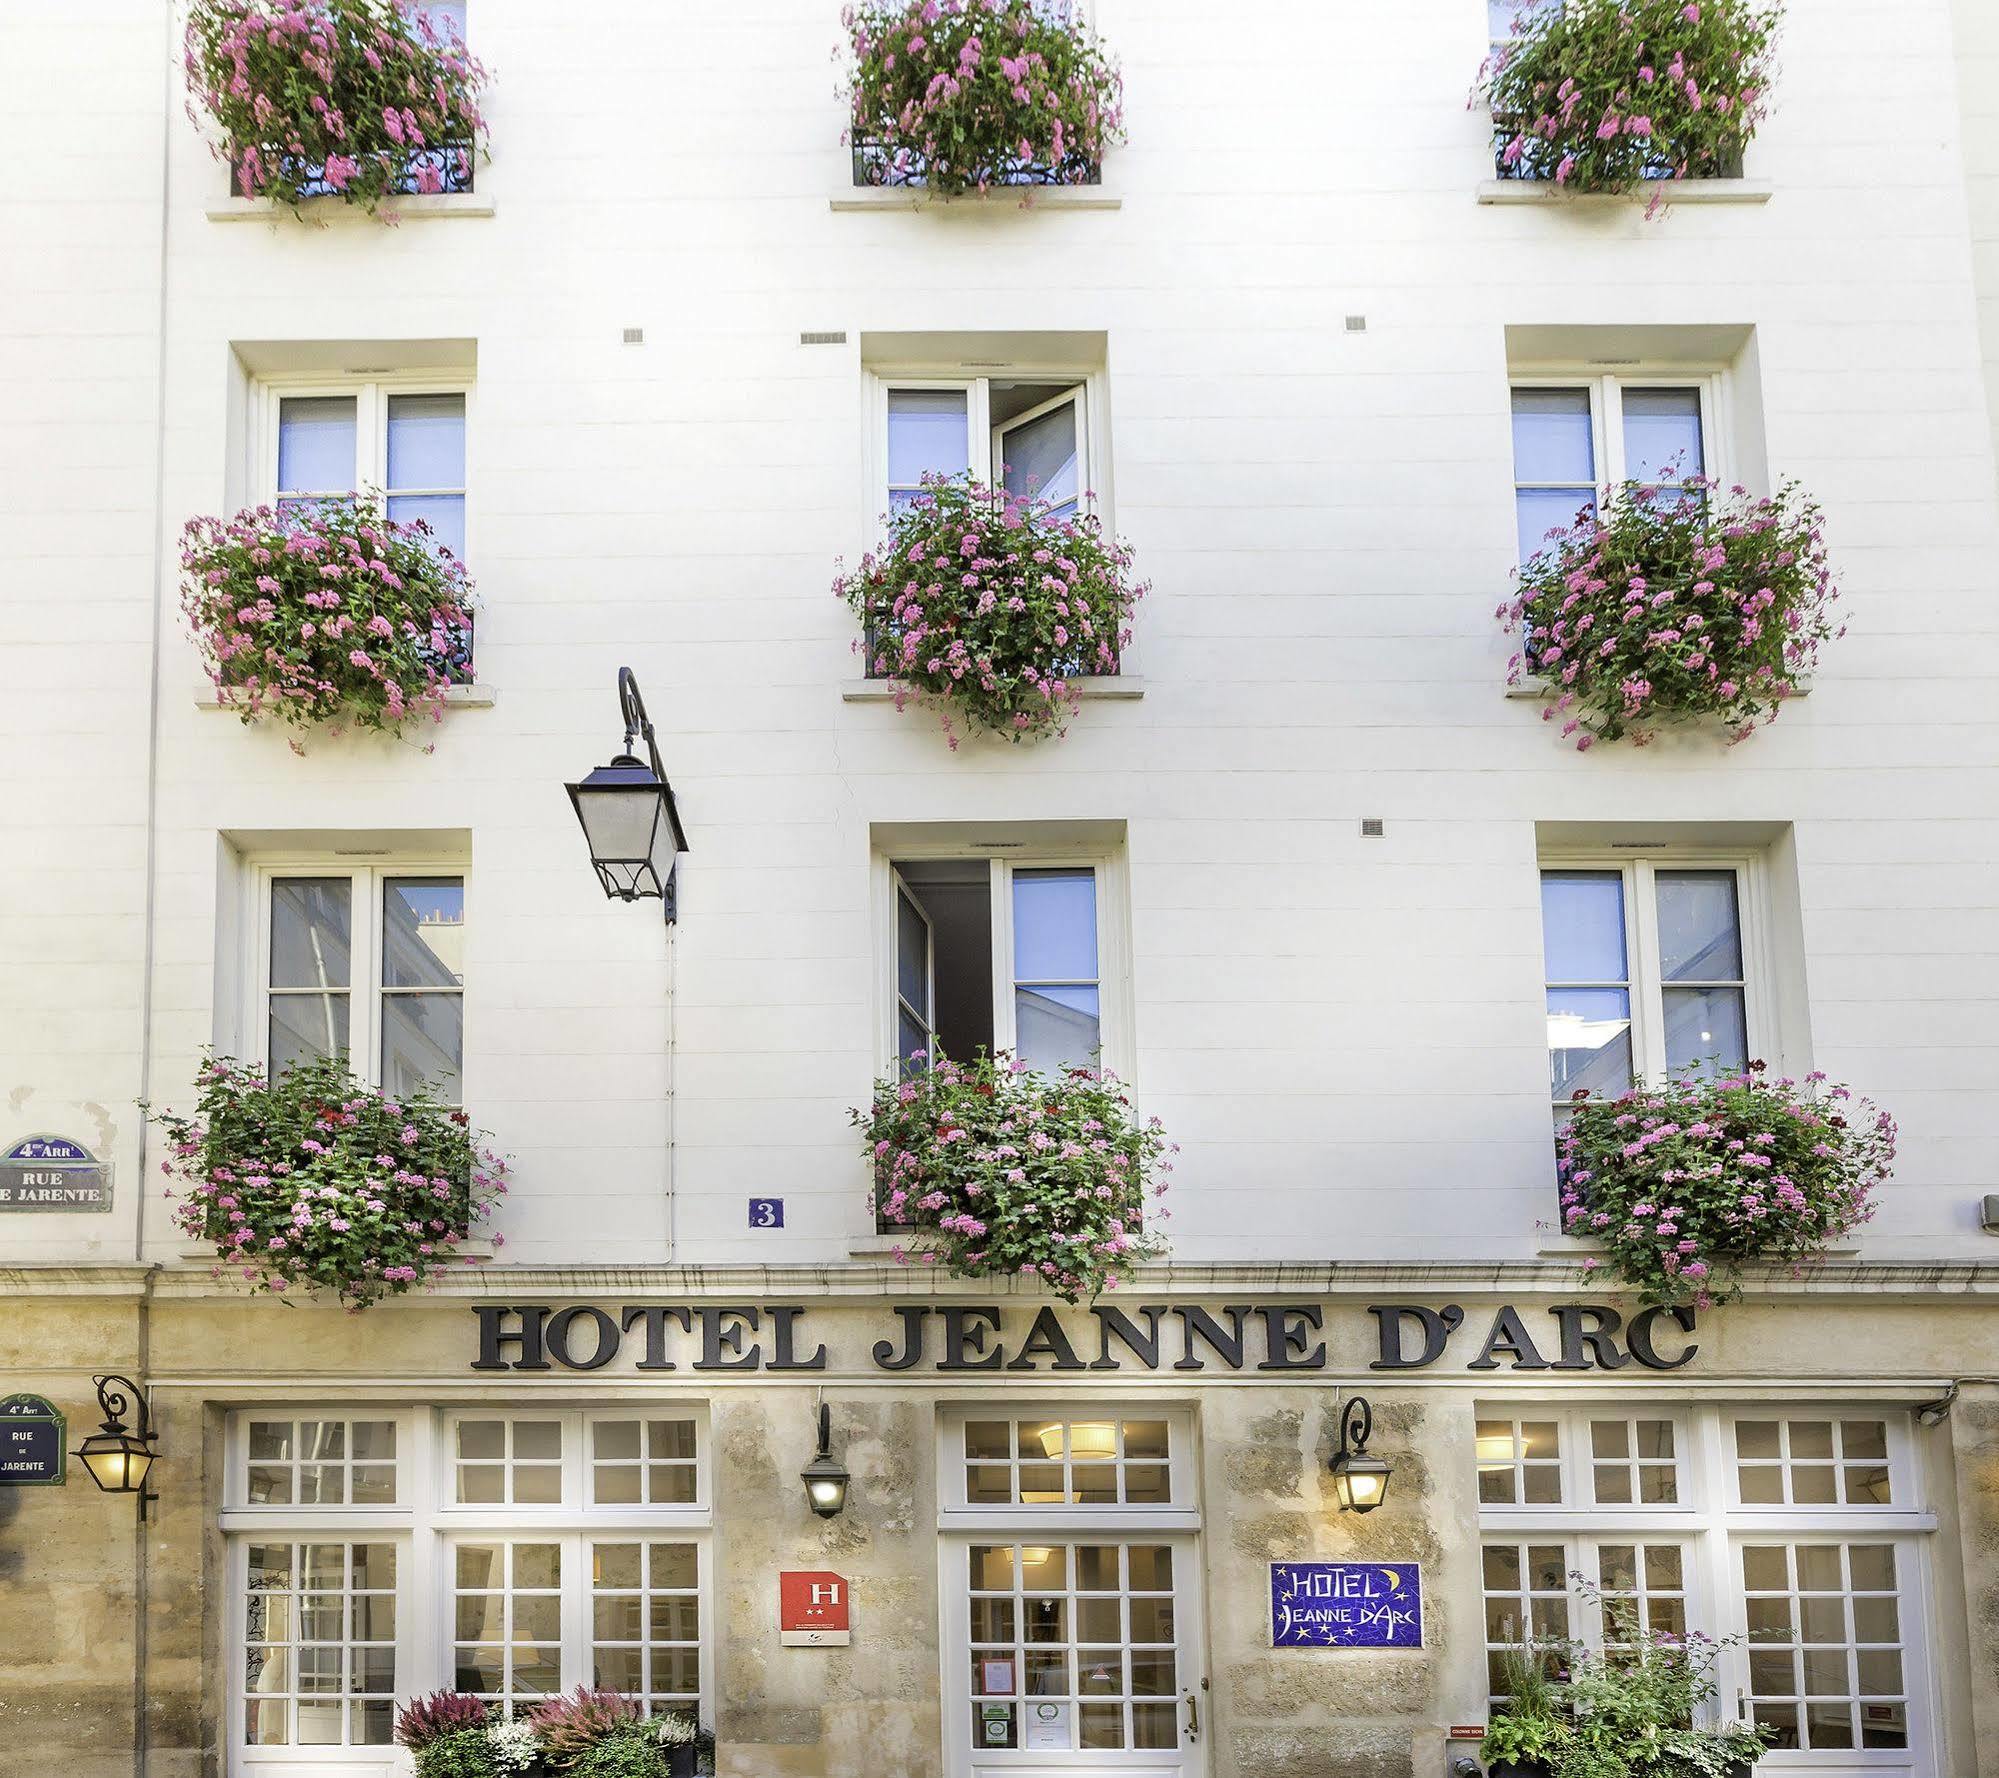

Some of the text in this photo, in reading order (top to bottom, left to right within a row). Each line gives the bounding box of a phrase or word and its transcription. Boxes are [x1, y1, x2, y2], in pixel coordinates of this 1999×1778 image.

[22, 1172, 64, 1186] RUE
[0, 1188, 12, 1201] E
[757, 1202, 776, 1226] 3
[470, 1303, 1700, 1371] HOTEL JEANNE D'ARC
[12, 1431, 34, 1441] RUE
[0, 1461, 45, 1471] JARENTE
[1291, 1567, 1381, 1598] HOTEL
[808, 1583, 842, 1605] H
[1277, 1597, 1419, 1640] JEANNE D'ARC
